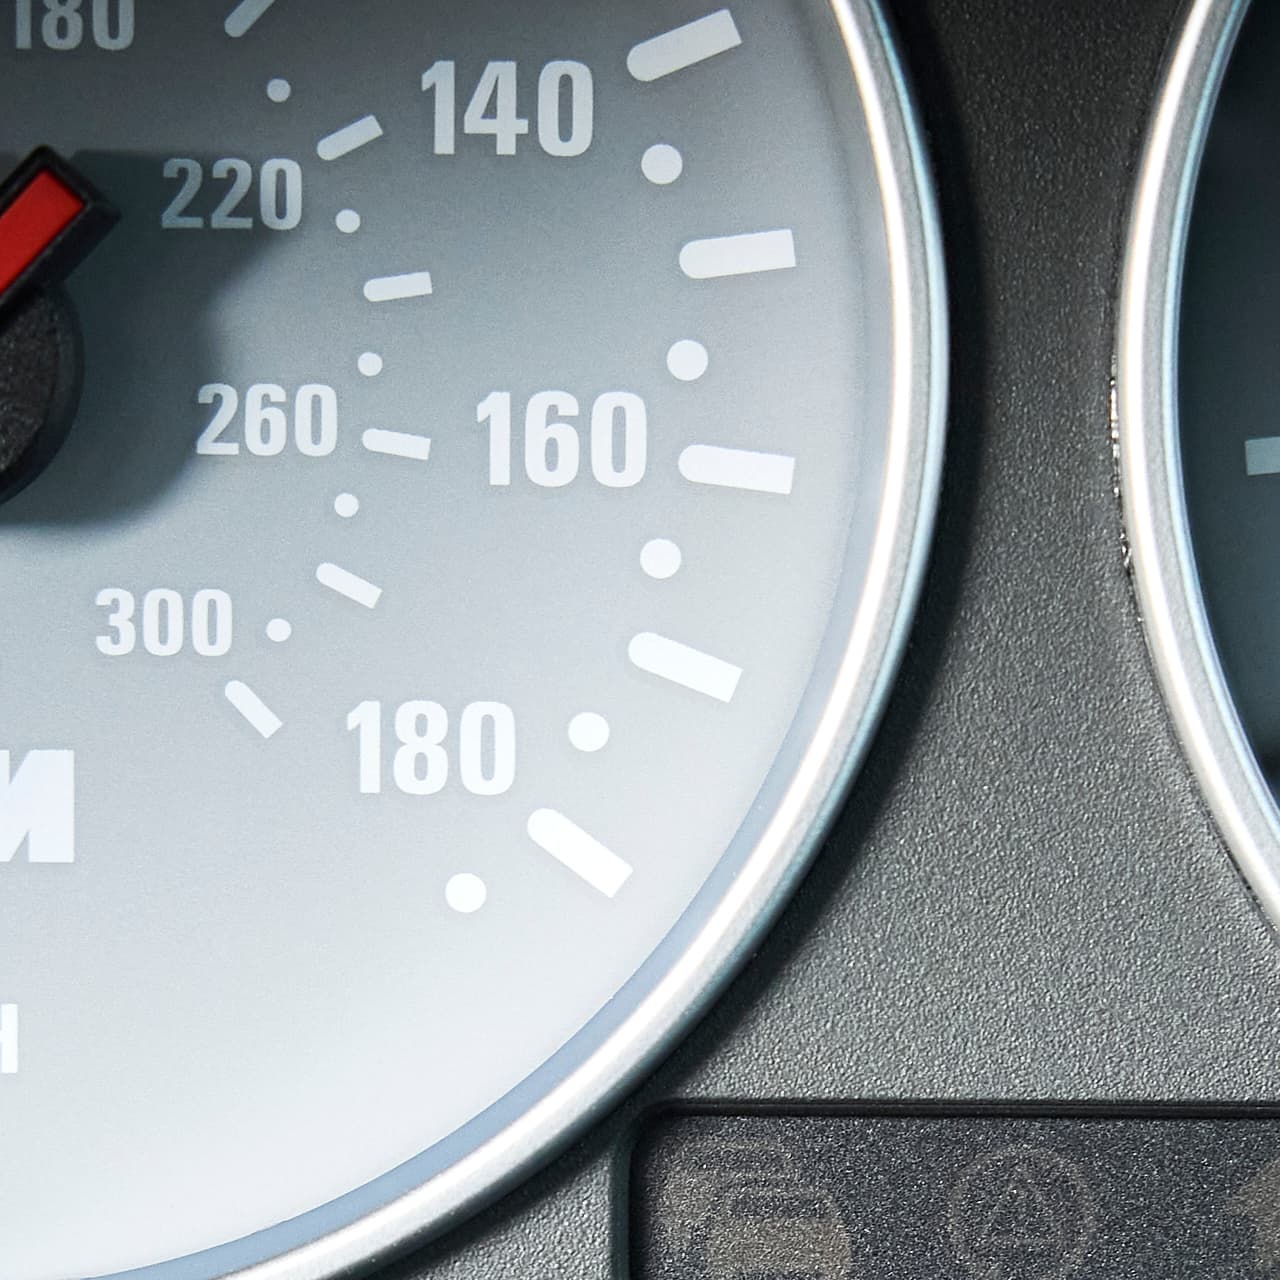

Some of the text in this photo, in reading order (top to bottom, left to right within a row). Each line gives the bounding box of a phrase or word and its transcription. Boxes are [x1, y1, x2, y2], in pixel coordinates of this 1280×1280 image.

[422, 60, 593, 156] 140
[162, 158, 303, 230] 220
[196, 384, 338, 457] 260
[476, 391, 647, 487] 160
[96, 588, 232, 656] 300
[346, 700, 515, 795] 180
